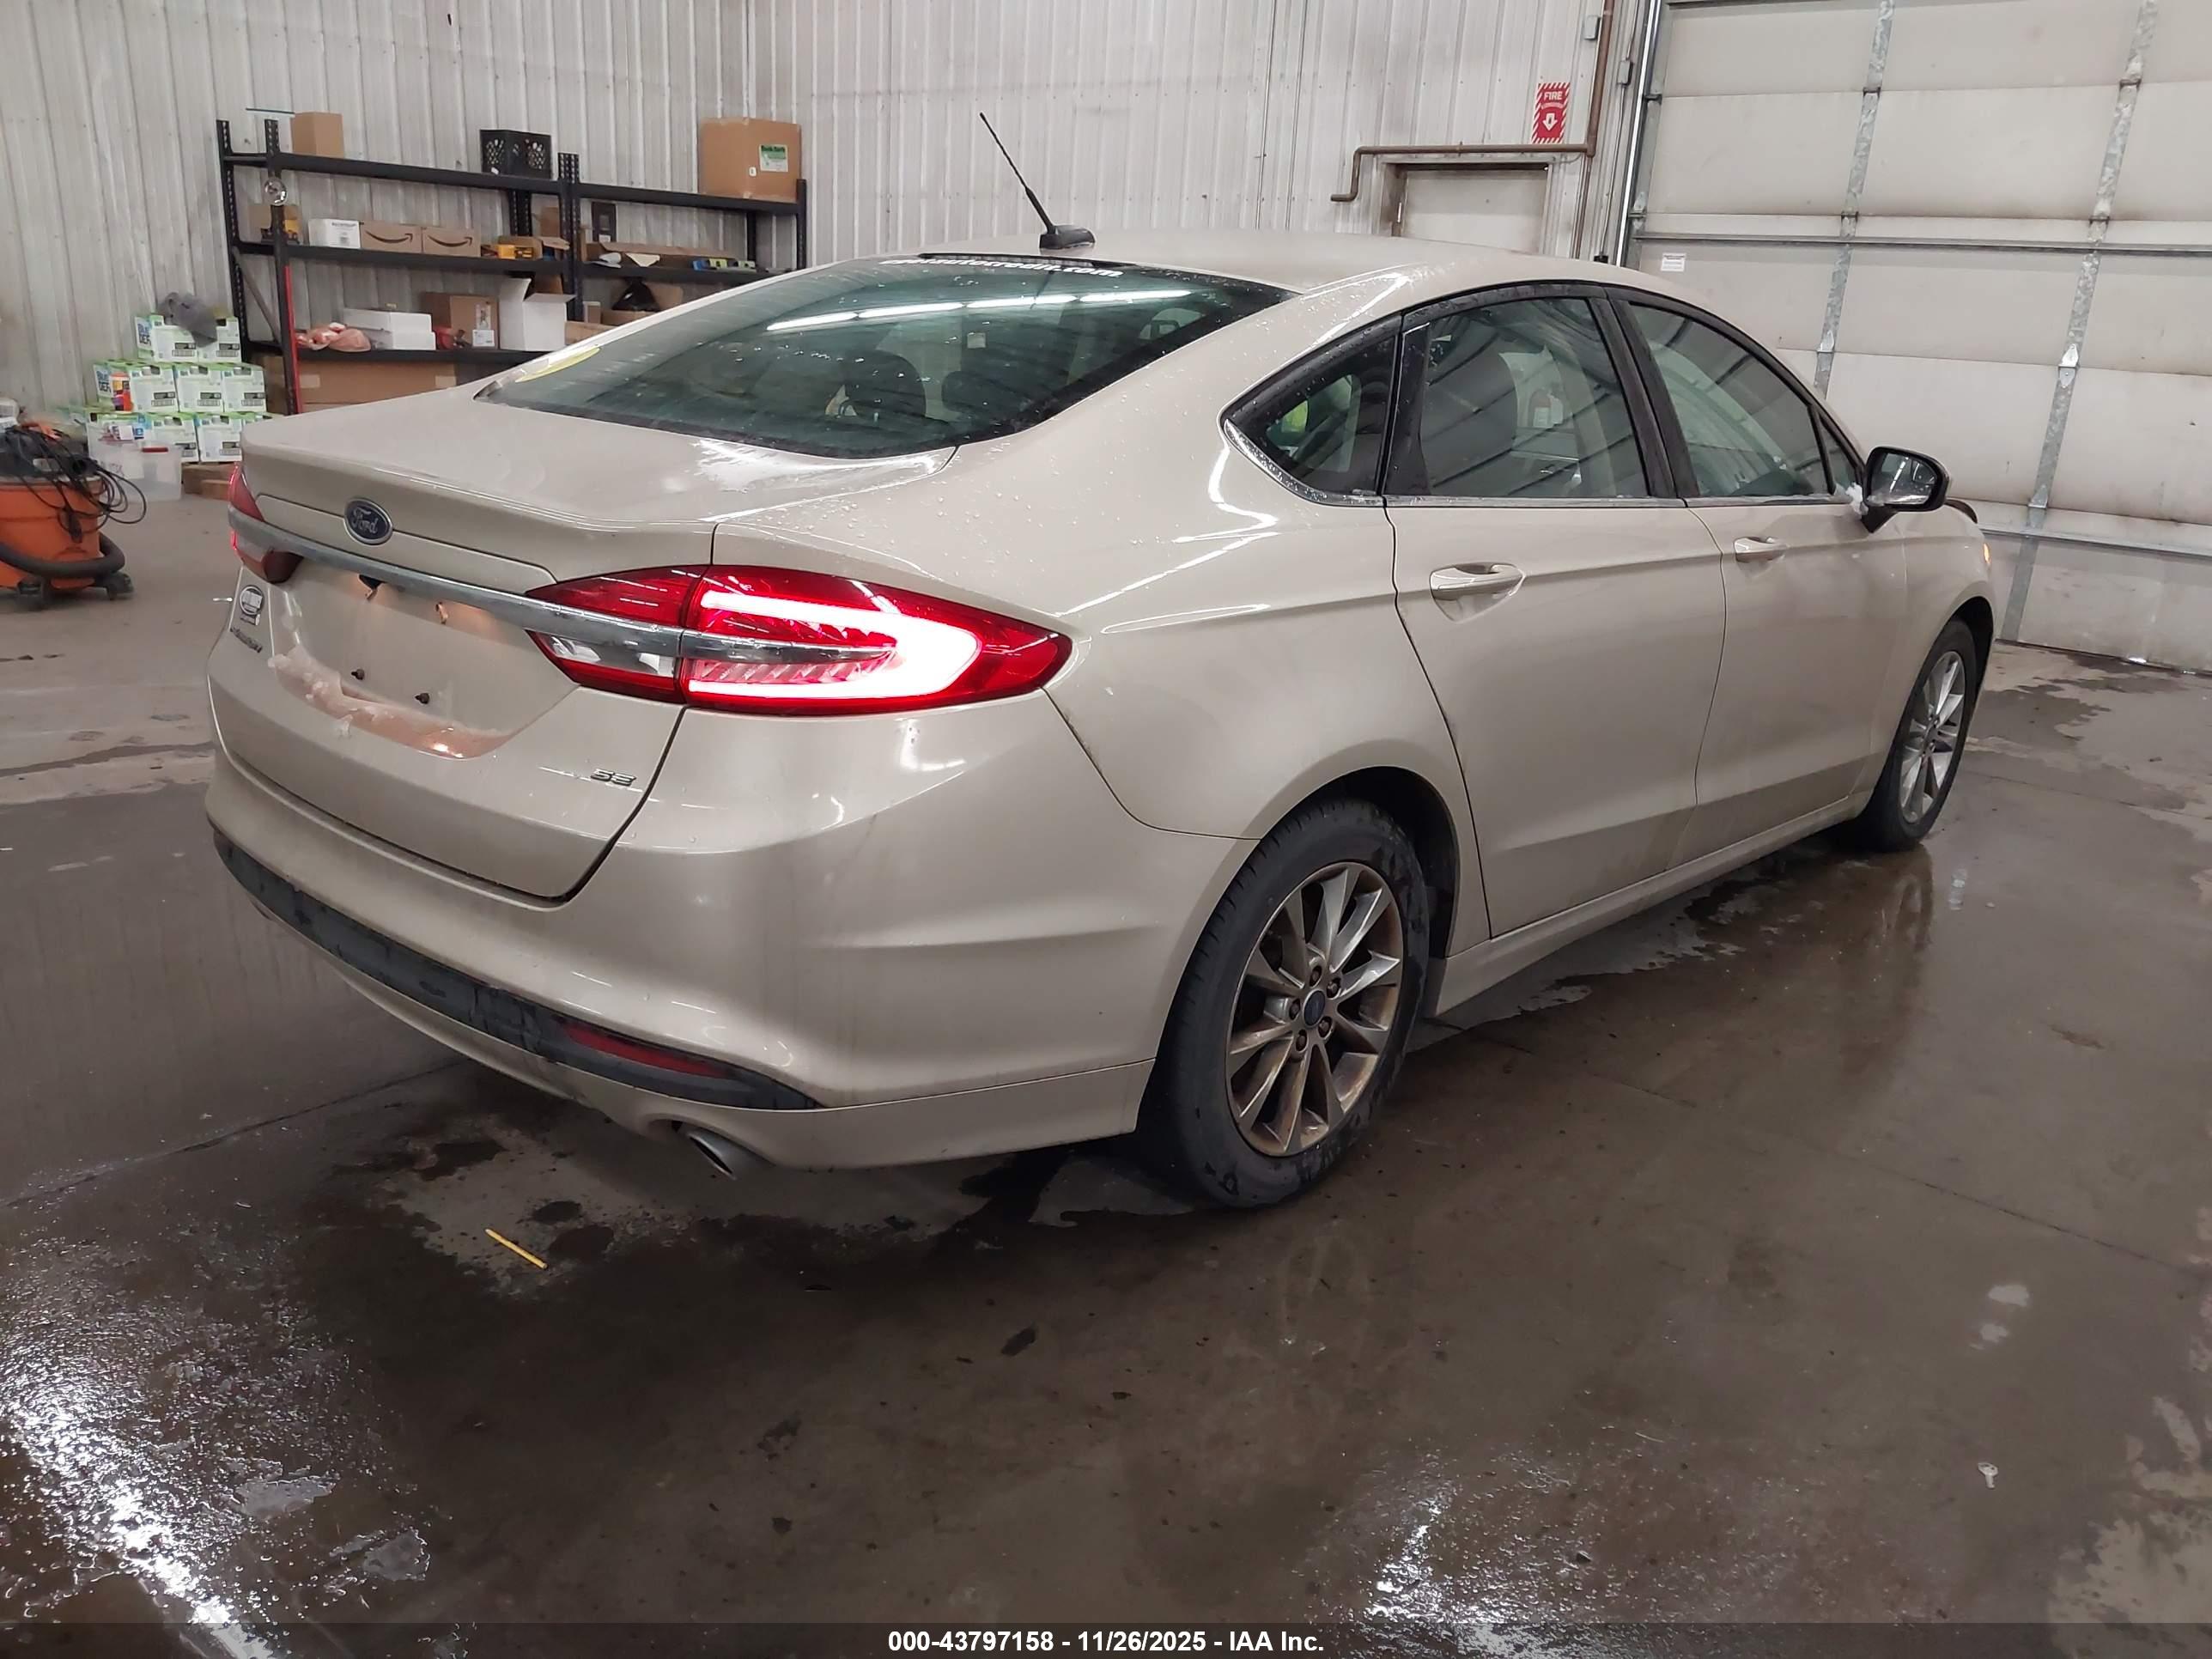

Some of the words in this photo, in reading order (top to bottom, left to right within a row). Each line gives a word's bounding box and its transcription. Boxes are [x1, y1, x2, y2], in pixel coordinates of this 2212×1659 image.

[1544, 91, 1563, 100] FIRE
[352, 507, 380, 534] Ford
[591, 769, 637, 787] SE
